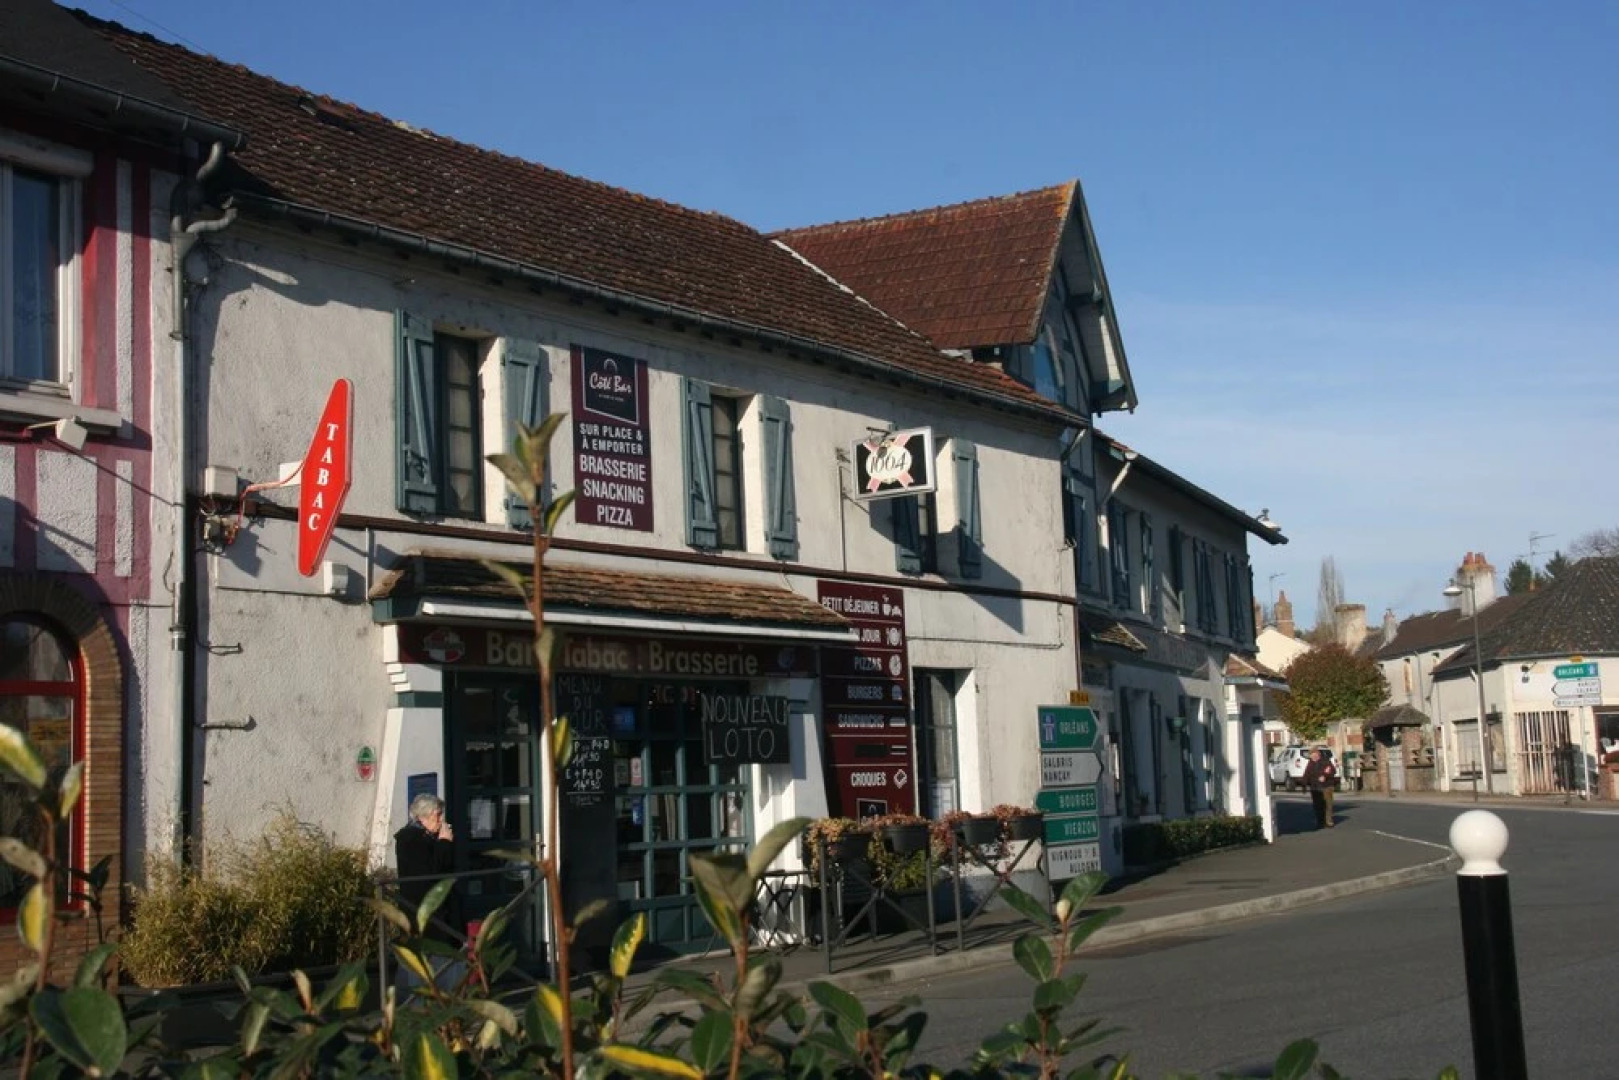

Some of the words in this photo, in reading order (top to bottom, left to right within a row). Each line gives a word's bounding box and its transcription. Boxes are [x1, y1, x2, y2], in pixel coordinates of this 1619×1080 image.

[579, 422, 600, 436] SUR
[601, 425, 633, 441] PLACE
[635, 429, 643, 441] &
[582, 435, 589, 450] À
[591, 438, 644, 456] EMPORTER
[308, 423, 339, 531] TABAC
[579, 454, 647, 482] BRASSERIE
[582, 478, 645, 505] SNACKING
[596, 504, 634, 527] PIZZA
[561, 633, 629, 670] Tabac
[649, 640, 760, 675] Brasserie
[700, 694, 788, 726] NOUVEAU
[709, 726, 775, 759] LOTO
[1059, 792, 1095, 809] BOURGES
[1064, 820, 1097, 836] VIERZON
